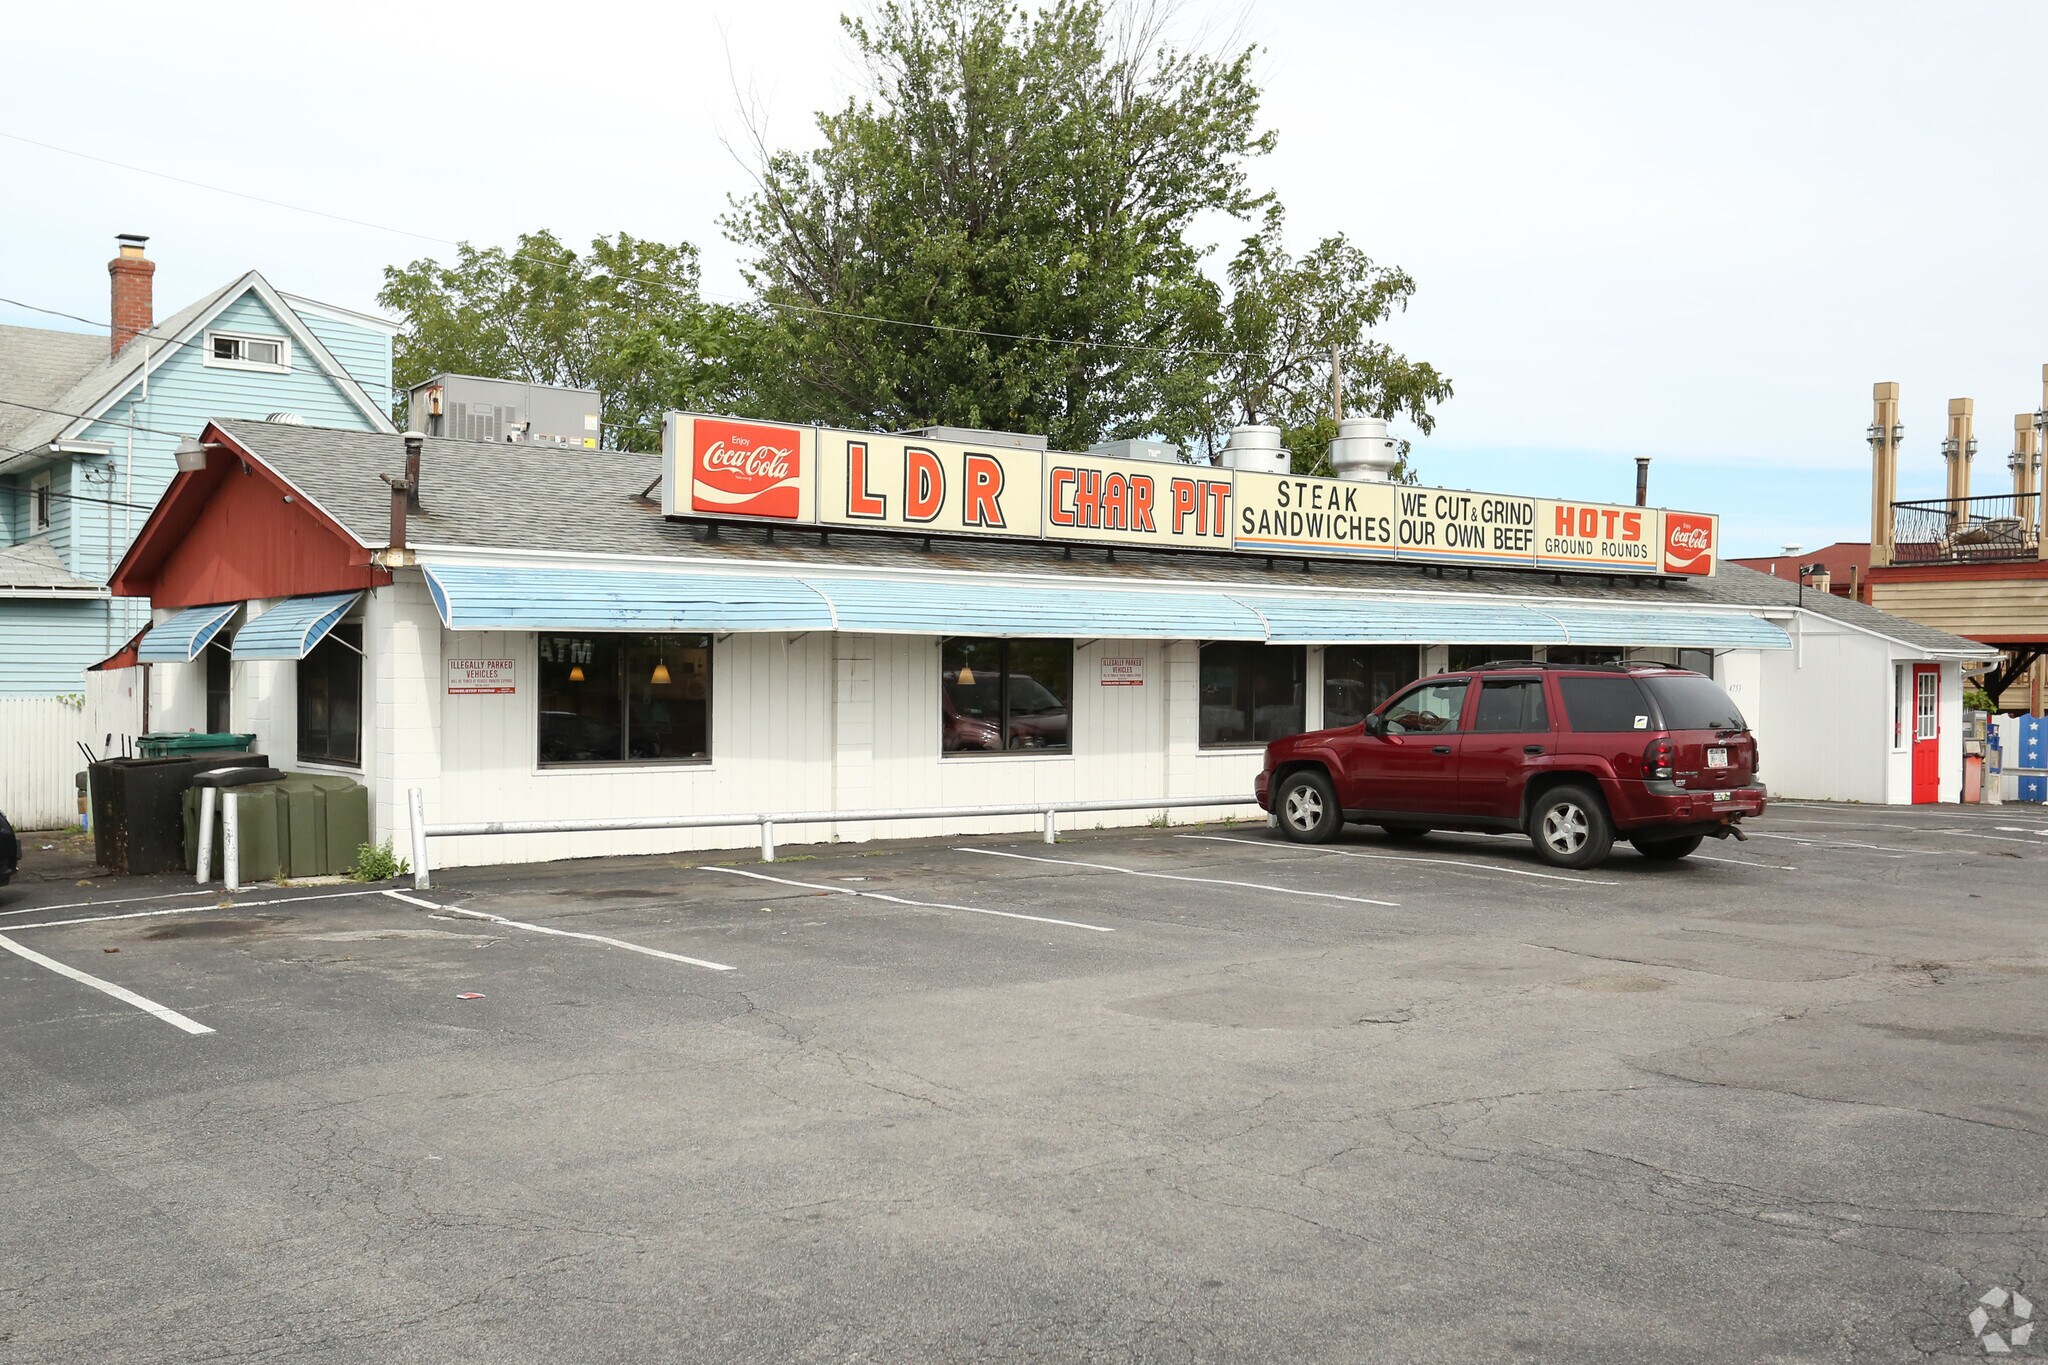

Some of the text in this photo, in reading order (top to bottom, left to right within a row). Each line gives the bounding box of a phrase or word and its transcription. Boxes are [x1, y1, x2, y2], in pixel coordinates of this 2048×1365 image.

[731, 435, 750, 446] Enjoy
[702, 440, 793, 479] Coca-Cola
[1049, 465, 1231, 537] CHAR PIT
[1277, 480, 1358, 512] STEAK
[1401, 492, 1428, 517] WE
[1242, 506, 1391, 543] SANDWICHES
[1399, 519, 1533, 552] OUR OWN BEEF
[1555, 505, 1642, 542] HOTS
[1545, 537, 1648, 559] GROUND ROUNDS
[1671, 526, 1710, 549] Coca-Cola
[540, 637, 592, 664] ATM
[450, 660, 513, 669] ILLEGALLY PARKED
[466, 669, 499, 678] VEHICLES
